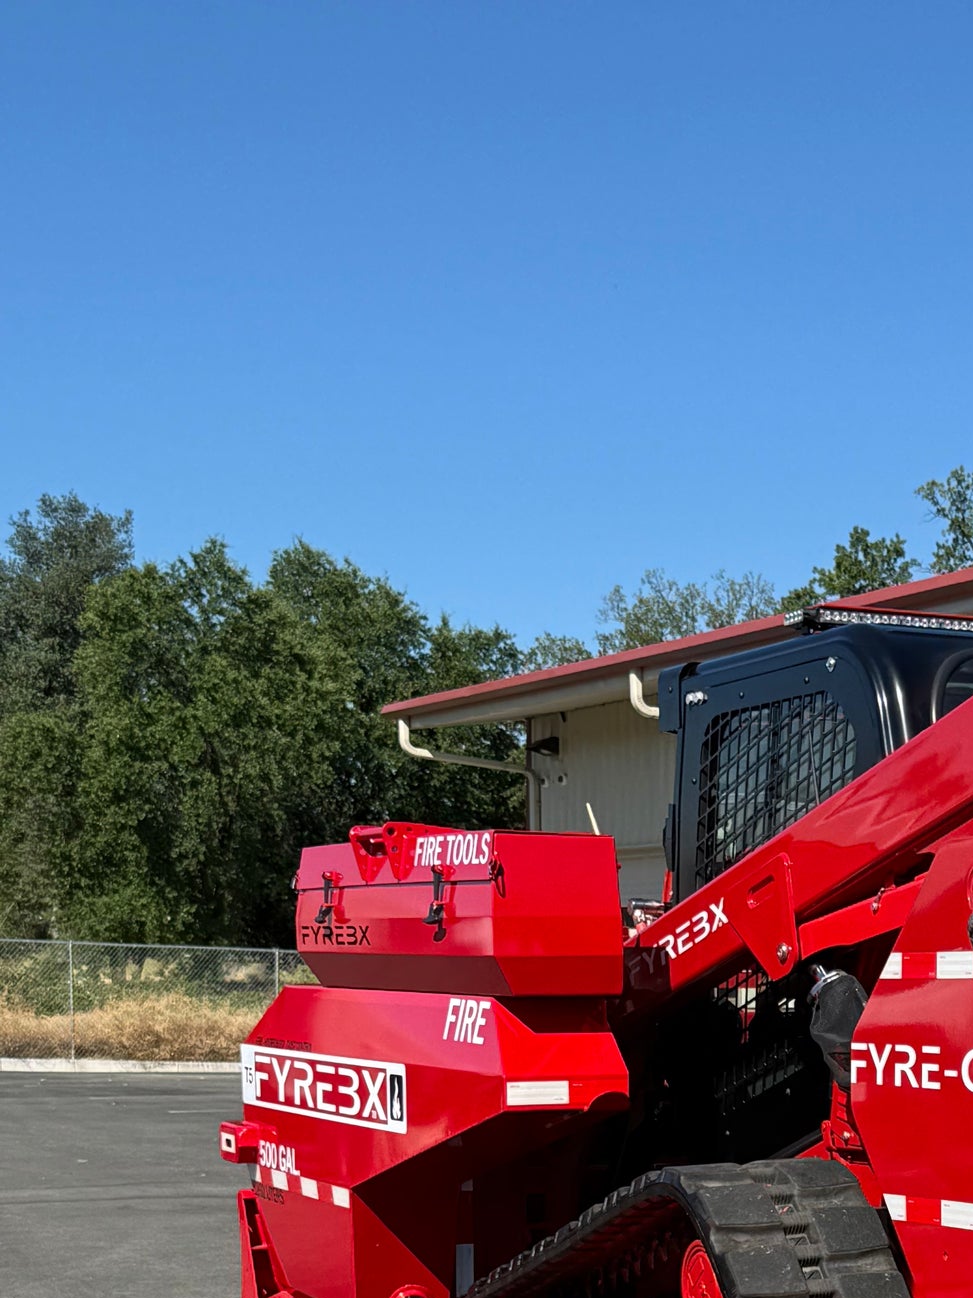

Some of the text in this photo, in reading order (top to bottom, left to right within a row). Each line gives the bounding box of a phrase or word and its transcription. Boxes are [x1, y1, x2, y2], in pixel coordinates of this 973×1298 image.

[413, 833, 491, 867] FIRE TOOLS
[442, 997, 492, 1045] FIRE
[244, 1066, 254, 1085] T5
[259, 1139, 301, 1176] 500 GAL
